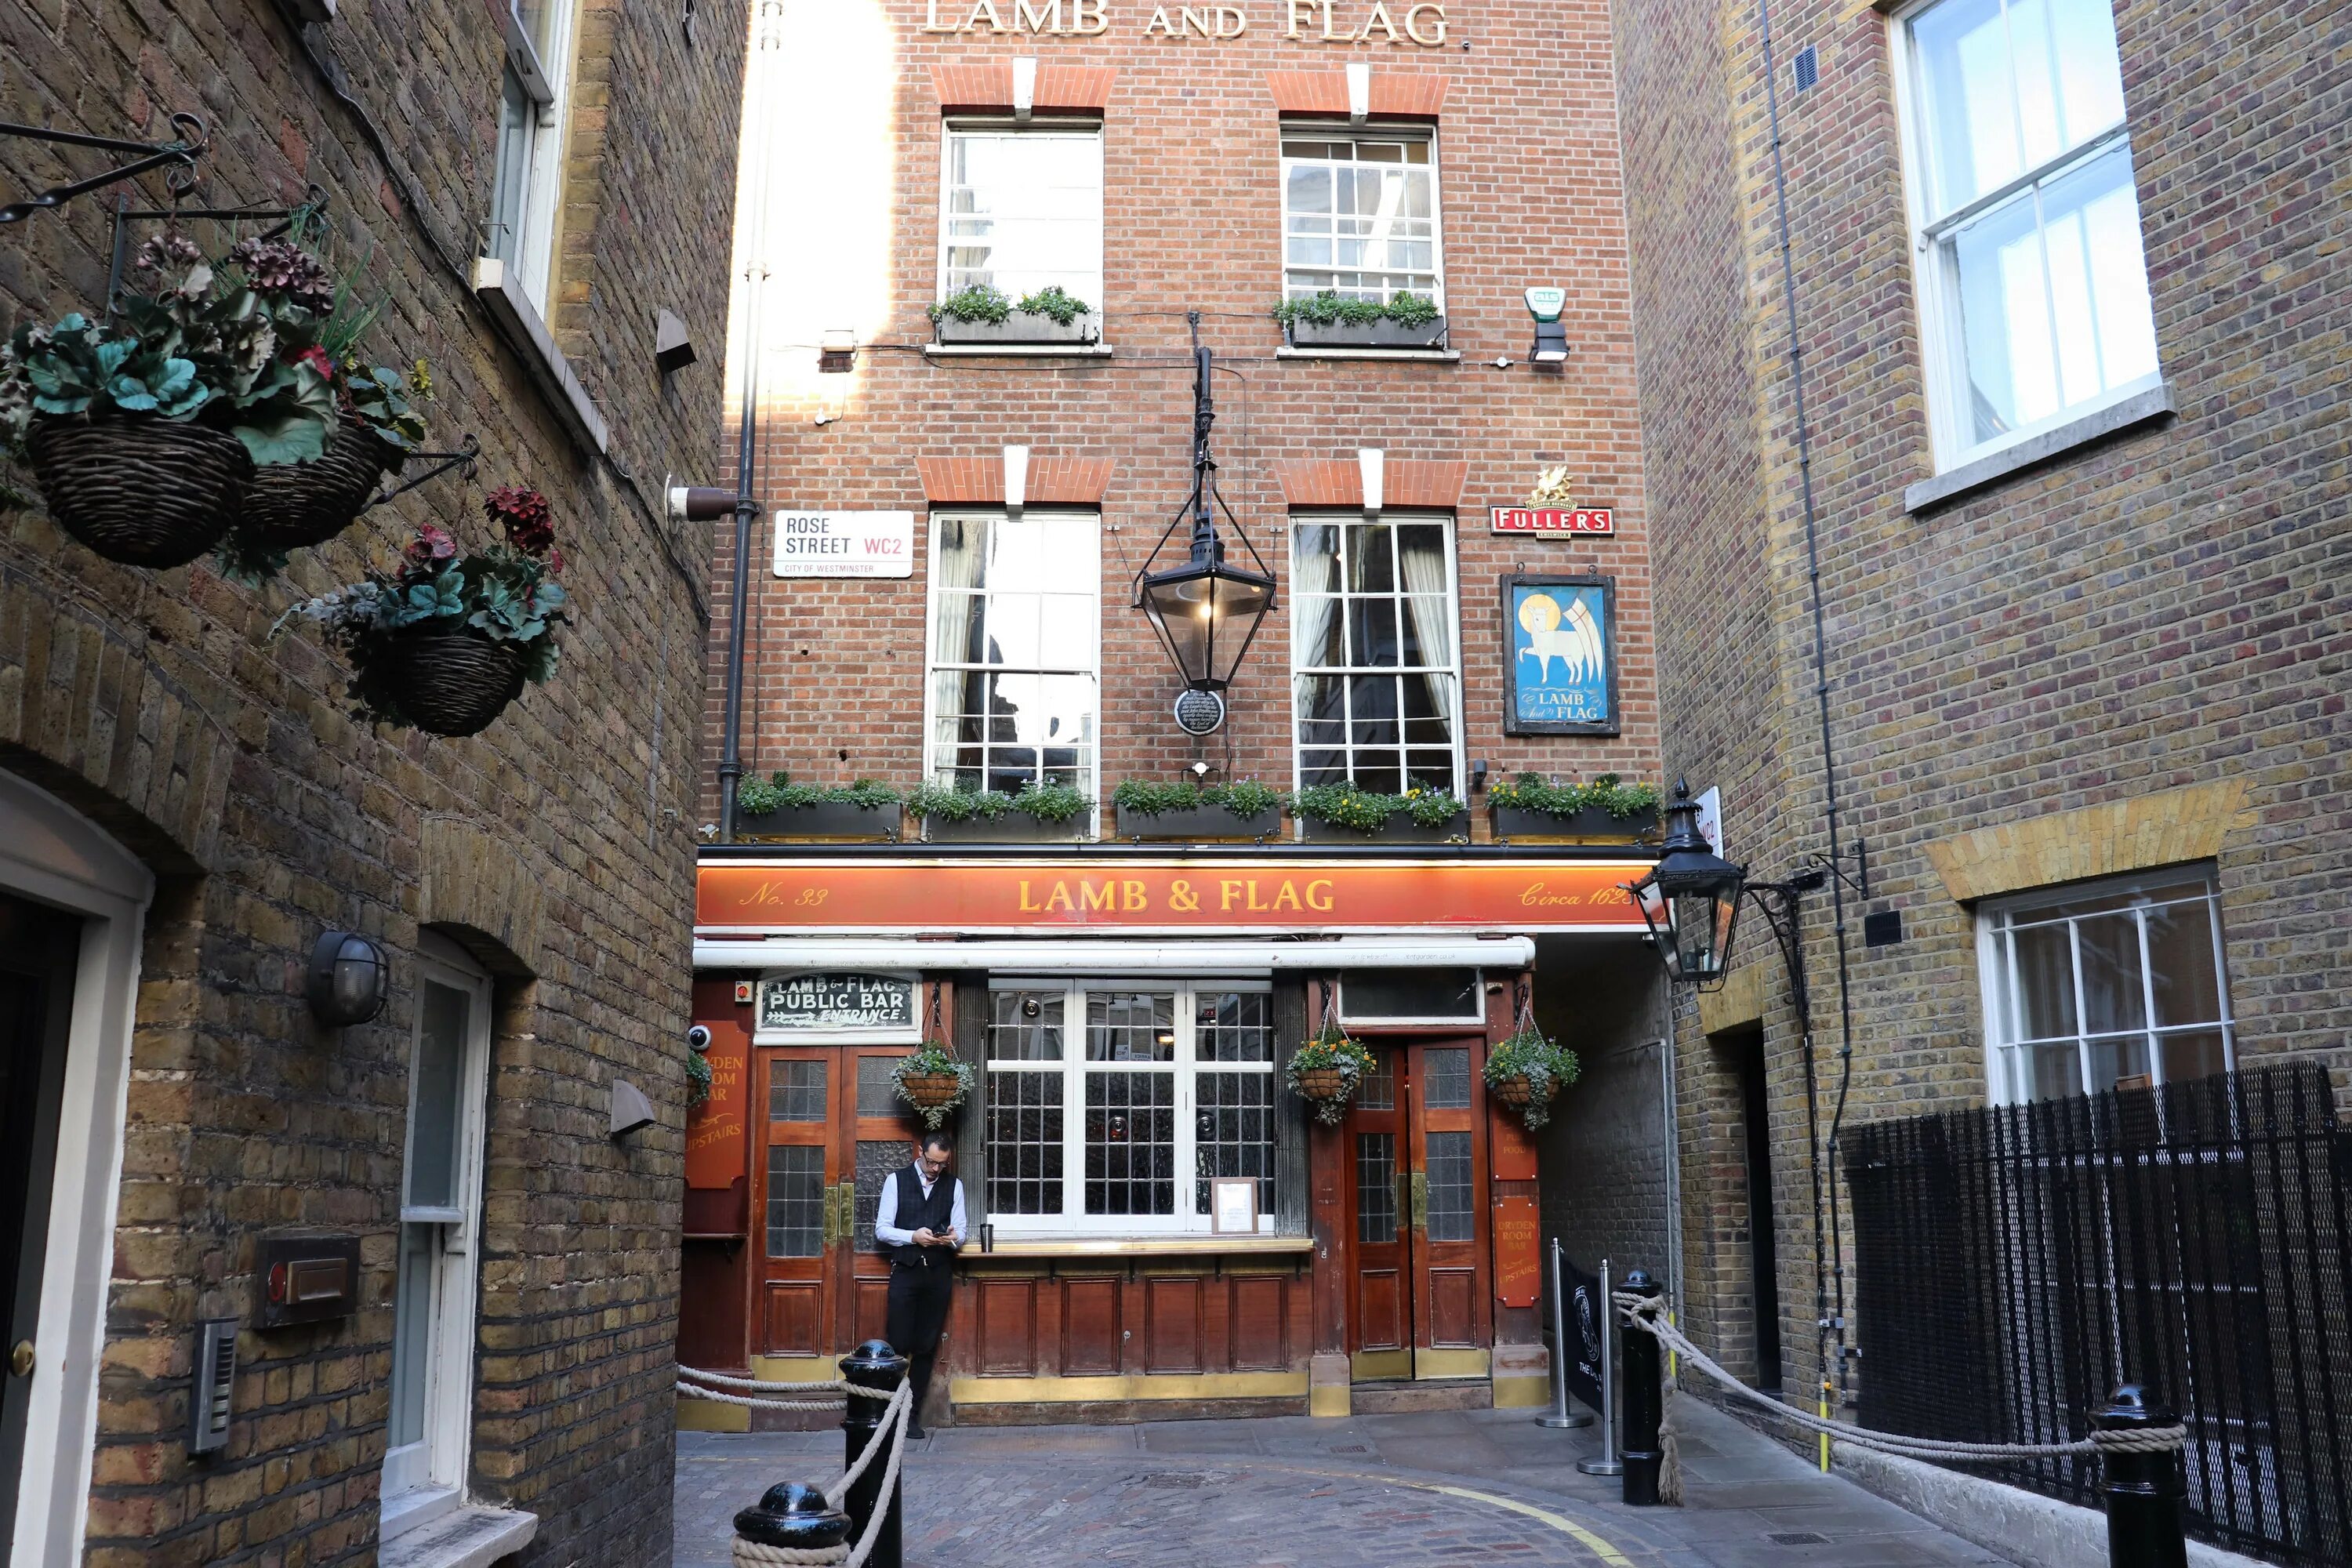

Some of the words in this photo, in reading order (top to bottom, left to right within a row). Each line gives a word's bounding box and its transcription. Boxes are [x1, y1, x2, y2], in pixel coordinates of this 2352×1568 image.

[920, 0, 1109, 35] LAMB
[1142, 5, 1248, 38] AND
[1283, 0, 1450, 47] FLAG
[786, 517, 830, 534] ROSE
[1498, 509, 1606, 532] FULLER'S
[786, 537, 851, 554] STREET
[864, 538, 902, 554] WC2
[784, 564, 802, 573] CITY
[804, 564, 814, 573] OF
[816, 564, 874, 573] WESTMINSTER
[1538, 692, 1584, 706] LAMB
[1556, 706, 1598, 719] FLAG
[739, 881, 784, 906] No.
[794, 888, 829, 906] 33
[1018, 880, 1148, 912] LAMB
[1168, 879, 1200, 912] &
[1220, 879, 1334, 912] FLAG
[1517, 882, 1582, 906] Circa
[778, 978, 827, 993] LAMB
[770, 993, 849, 1009] PUBLIC
[861, 993, 904, 1008] BAR
[707, 1088, 728, 1101] AR
[1498, 1221, 1536, 1230] DRYDEN
[1502, 1231, 1532, 1240] ROOM
[1579, 1361, 1591, 1375] THE
